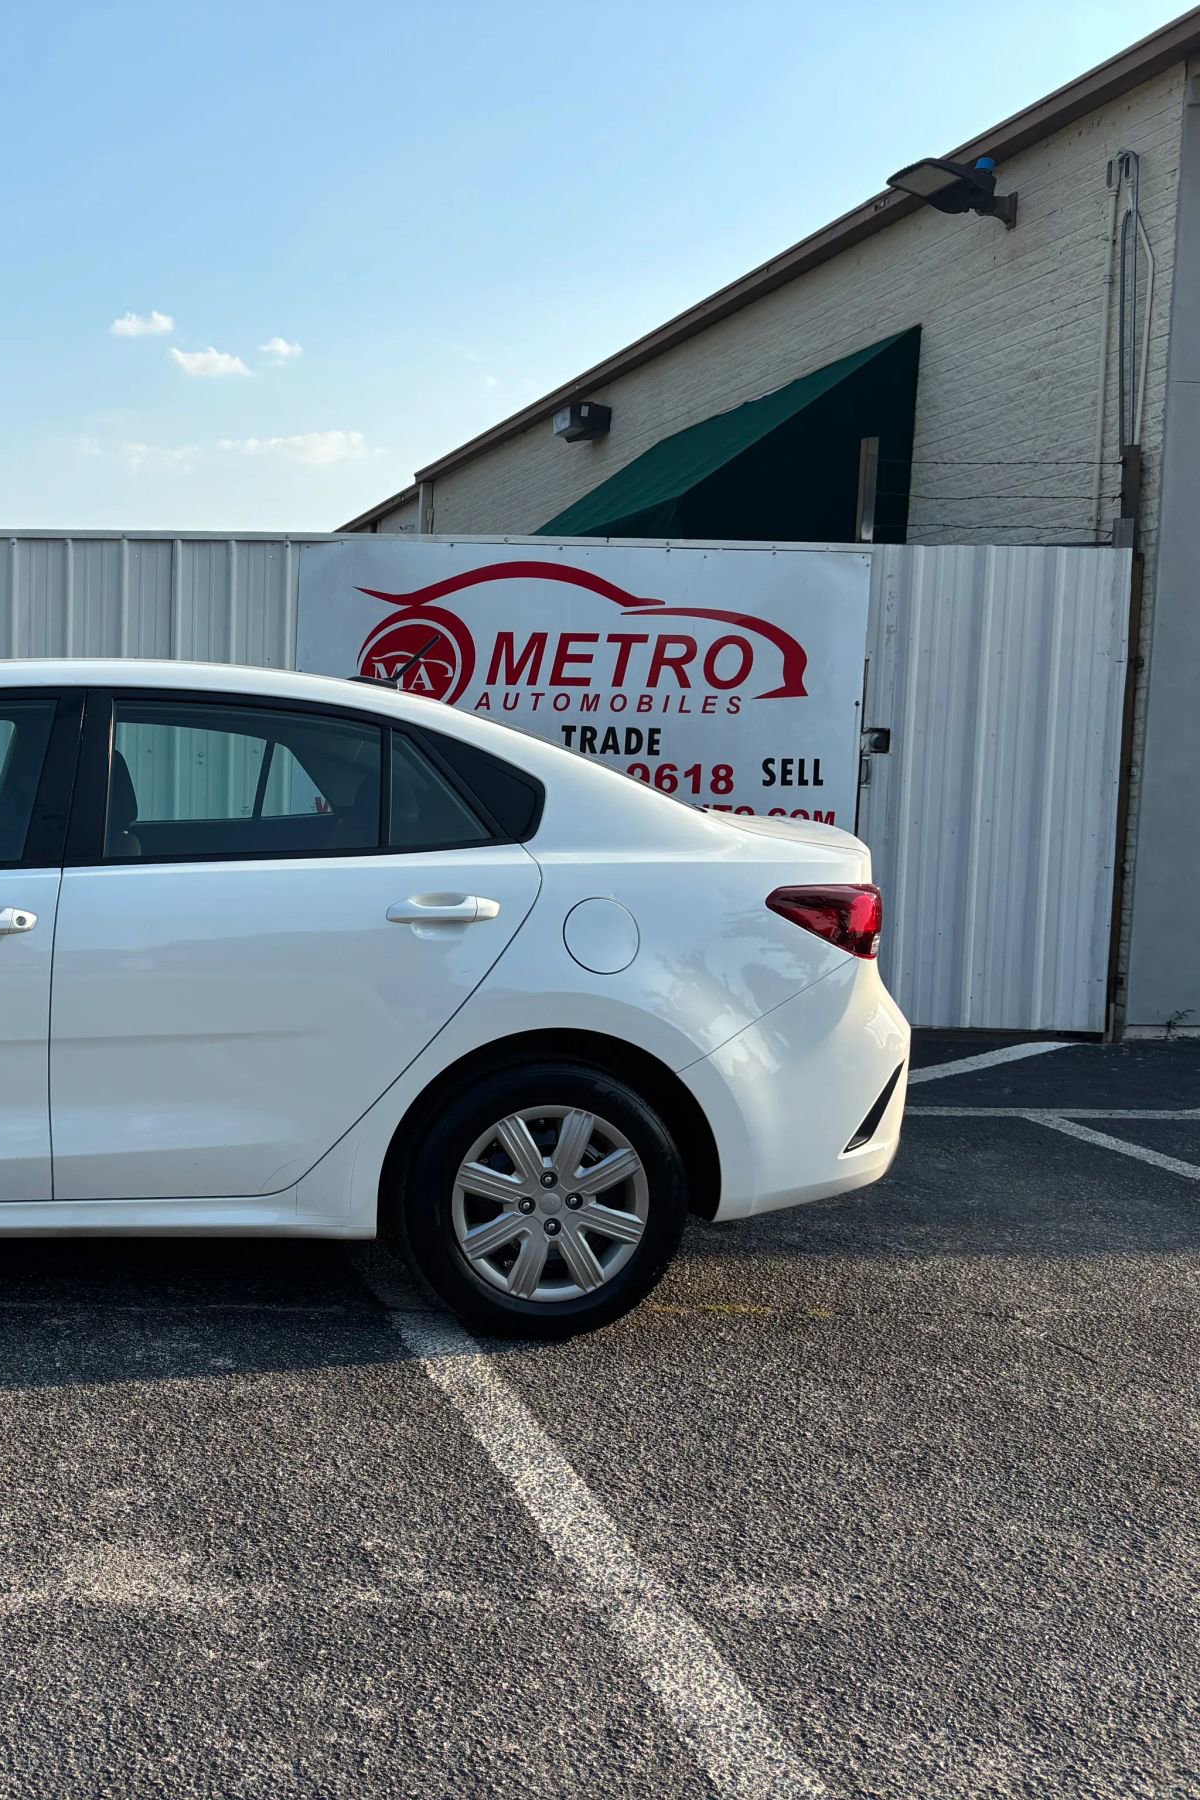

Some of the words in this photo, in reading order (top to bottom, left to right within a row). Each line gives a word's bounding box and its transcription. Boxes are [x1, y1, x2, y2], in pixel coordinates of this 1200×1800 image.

[485, 631, 754, 690] METRO
[474, 692, 742, 714] AUTOMOBILES
[561, 725, 662, 756] TRADE
[761, 757, 824, 787] SELL
